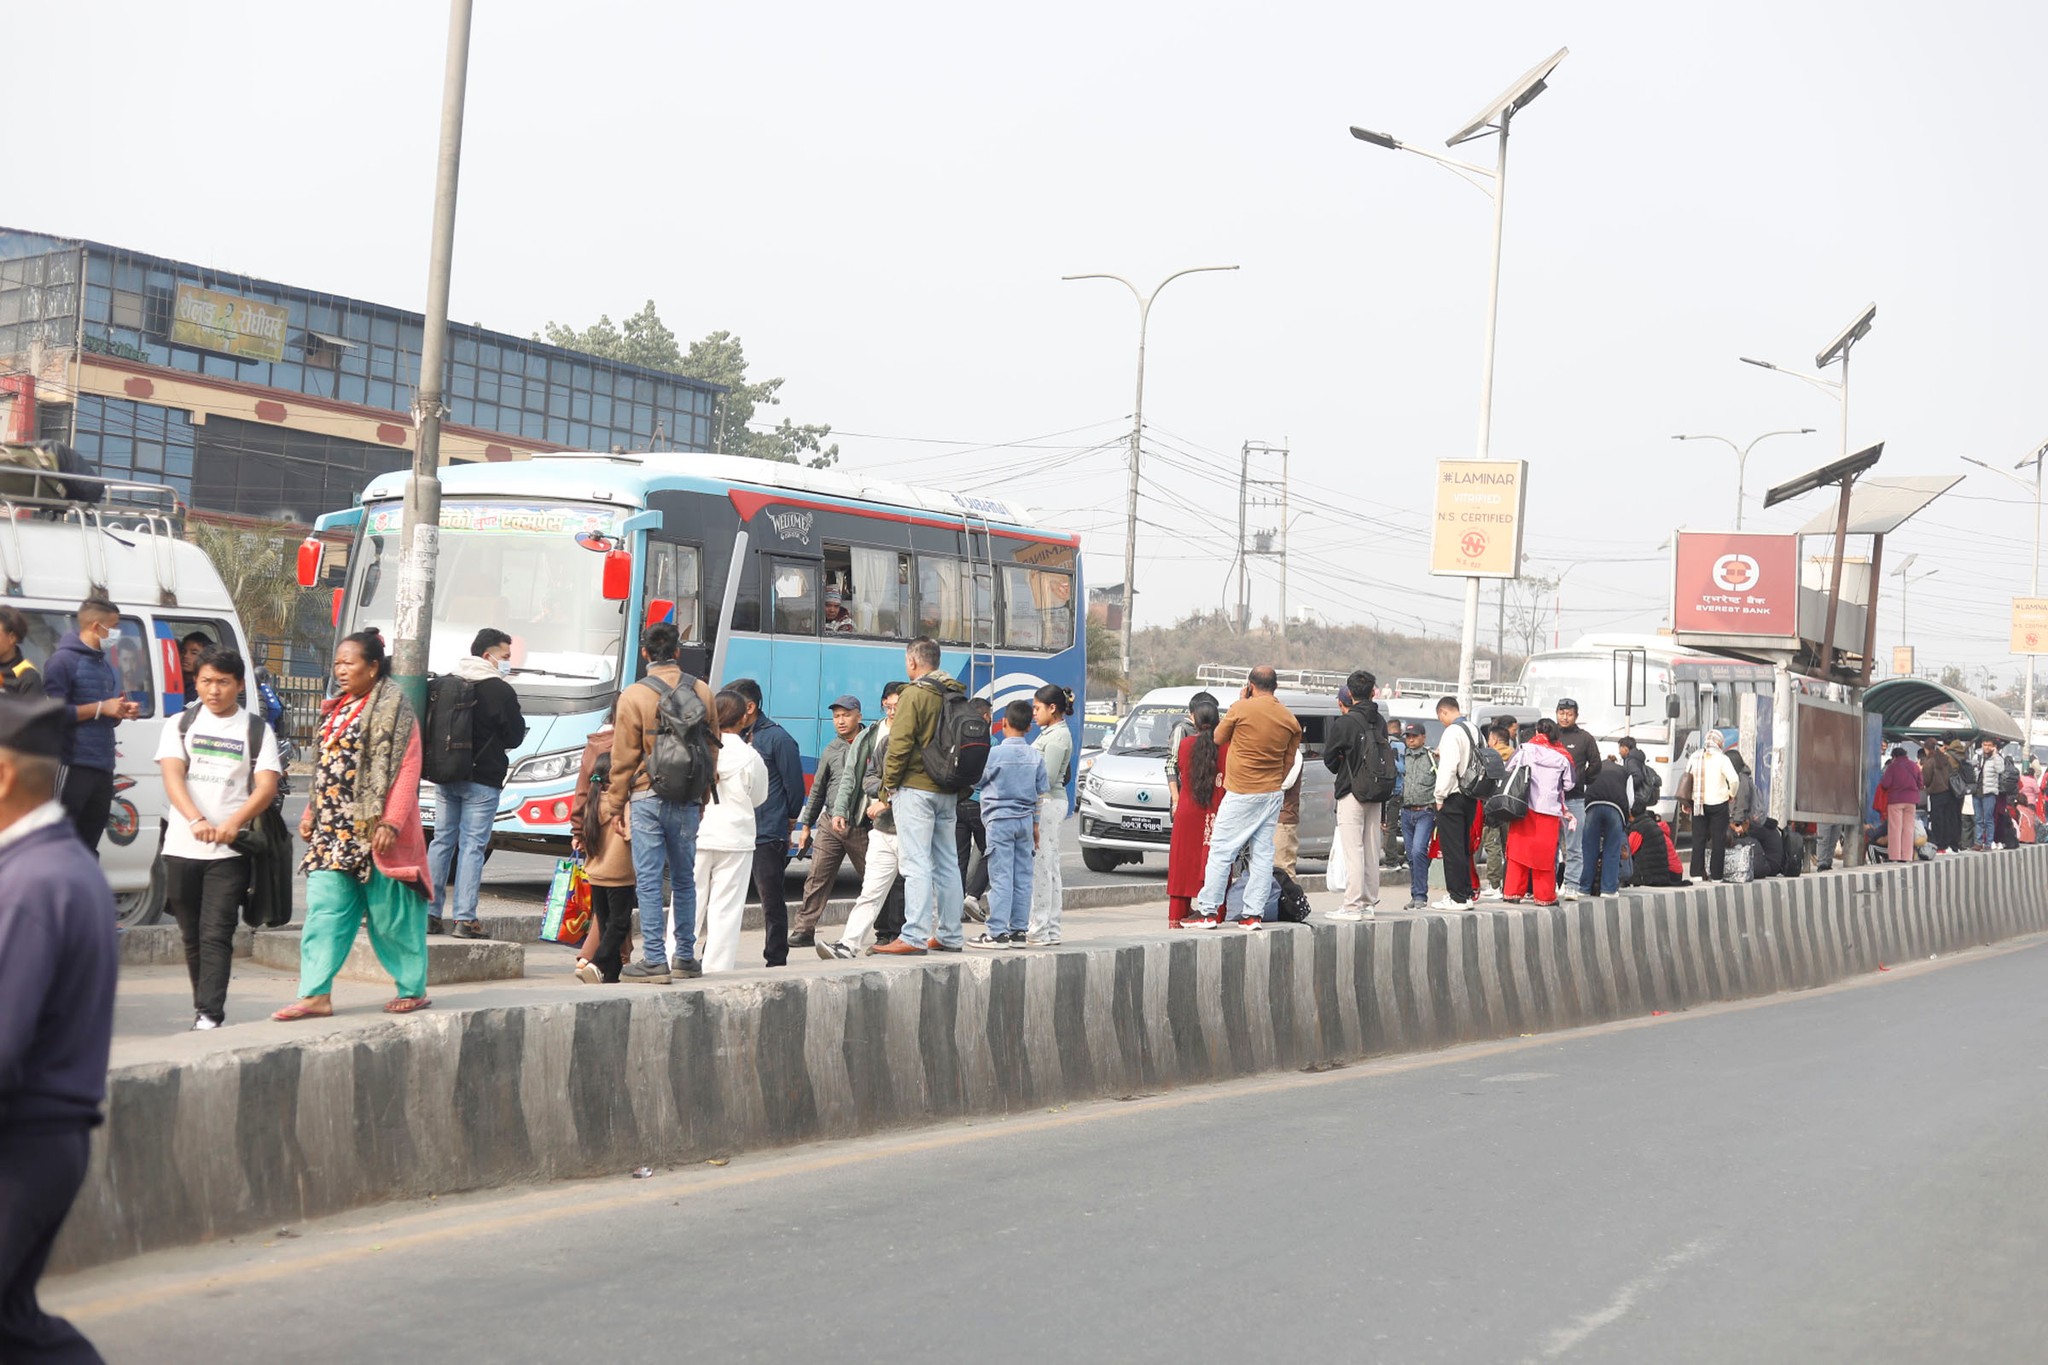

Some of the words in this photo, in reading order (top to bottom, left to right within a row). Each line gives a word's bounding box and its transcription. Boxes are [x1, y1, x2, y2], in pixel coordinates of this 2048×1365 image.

[1460, 512, 1514, 524] CERTIFIED
[1695, 604, 1741, 613] EVEREST
[1742, 607, 1771, 615] BANK
